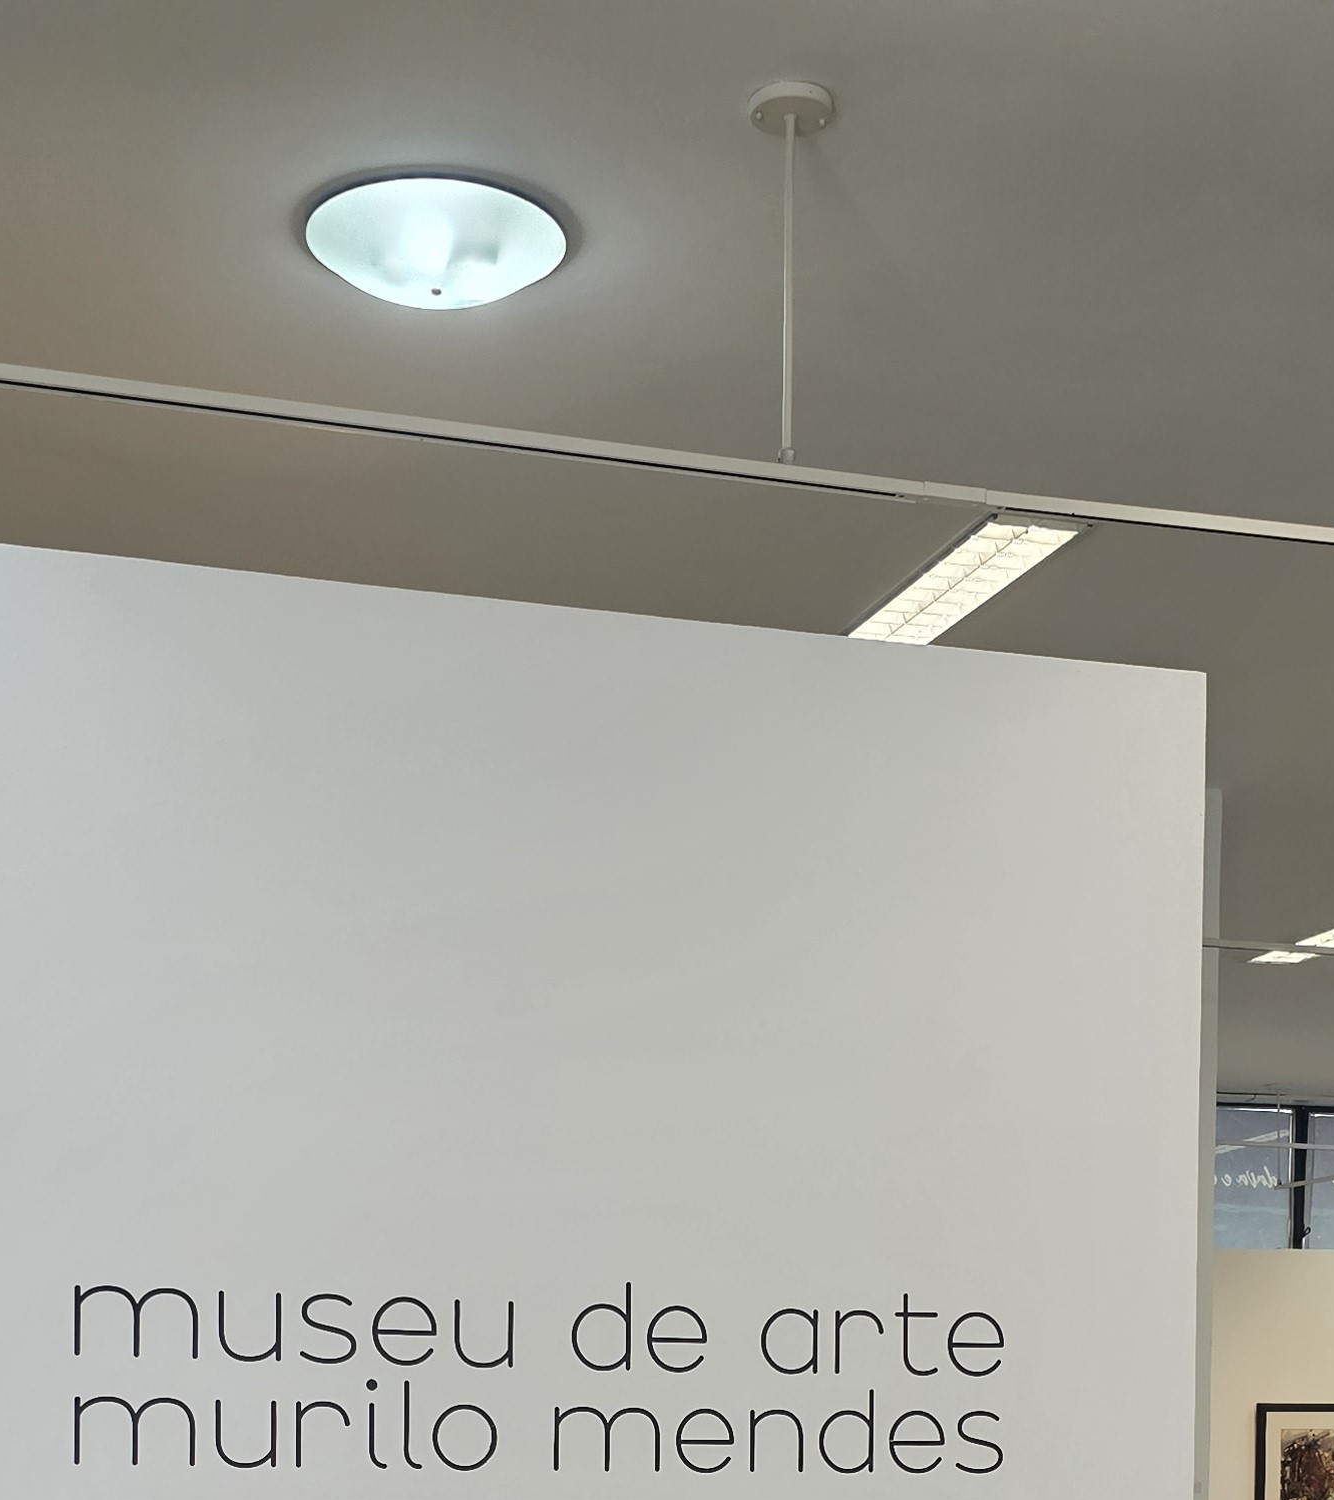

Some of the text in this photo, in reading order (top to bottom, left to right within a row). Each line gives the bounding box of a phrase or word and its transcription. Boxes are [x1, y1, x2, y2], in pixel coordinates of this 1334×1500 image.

[72, 1280, 1006, 1379] museu de arte
[72, 1377, 1005, 1476] murilo mendes
